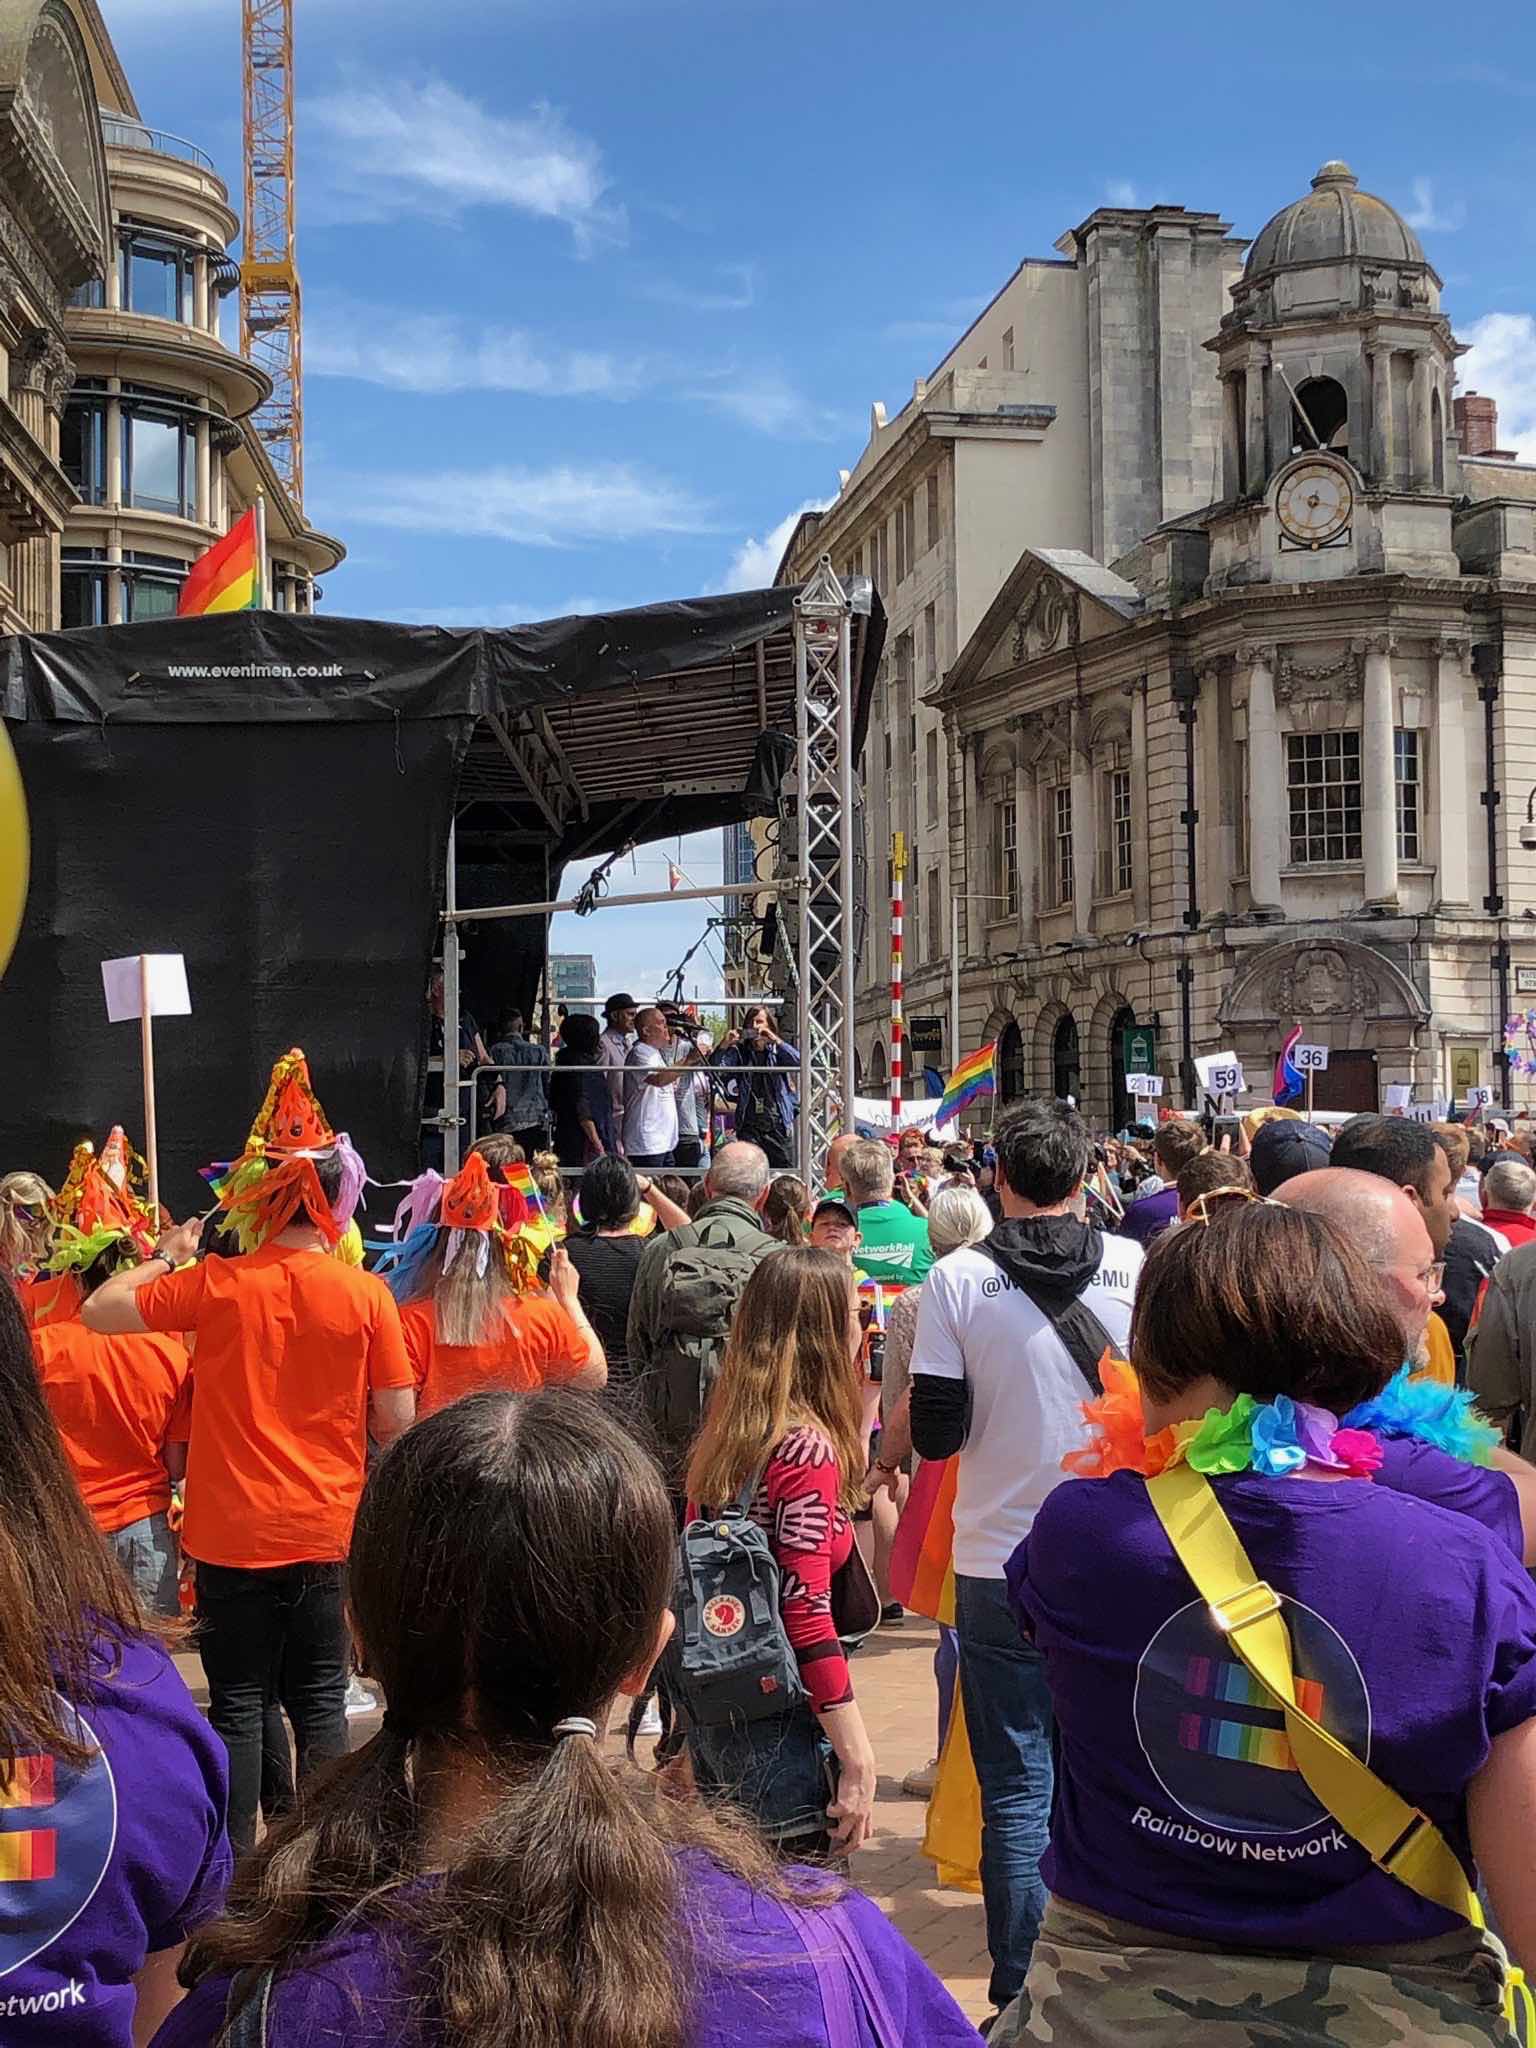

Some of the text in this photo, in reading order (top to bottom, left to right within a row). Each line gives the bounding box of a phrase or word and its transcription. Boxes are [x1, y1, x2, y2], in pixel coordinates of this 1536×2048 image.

[168, 664, 343, 678] www.eventmen.co.uk
[1300, 1050, 1322, 1066] 36
[1147, 1080, 1156, 1093] 11
[1215, 1069, 1236, 1089] 59
[1475, 1090, 1489, 1104] 18
[1131, 1806, 1348, 1862] Rainbow Network
